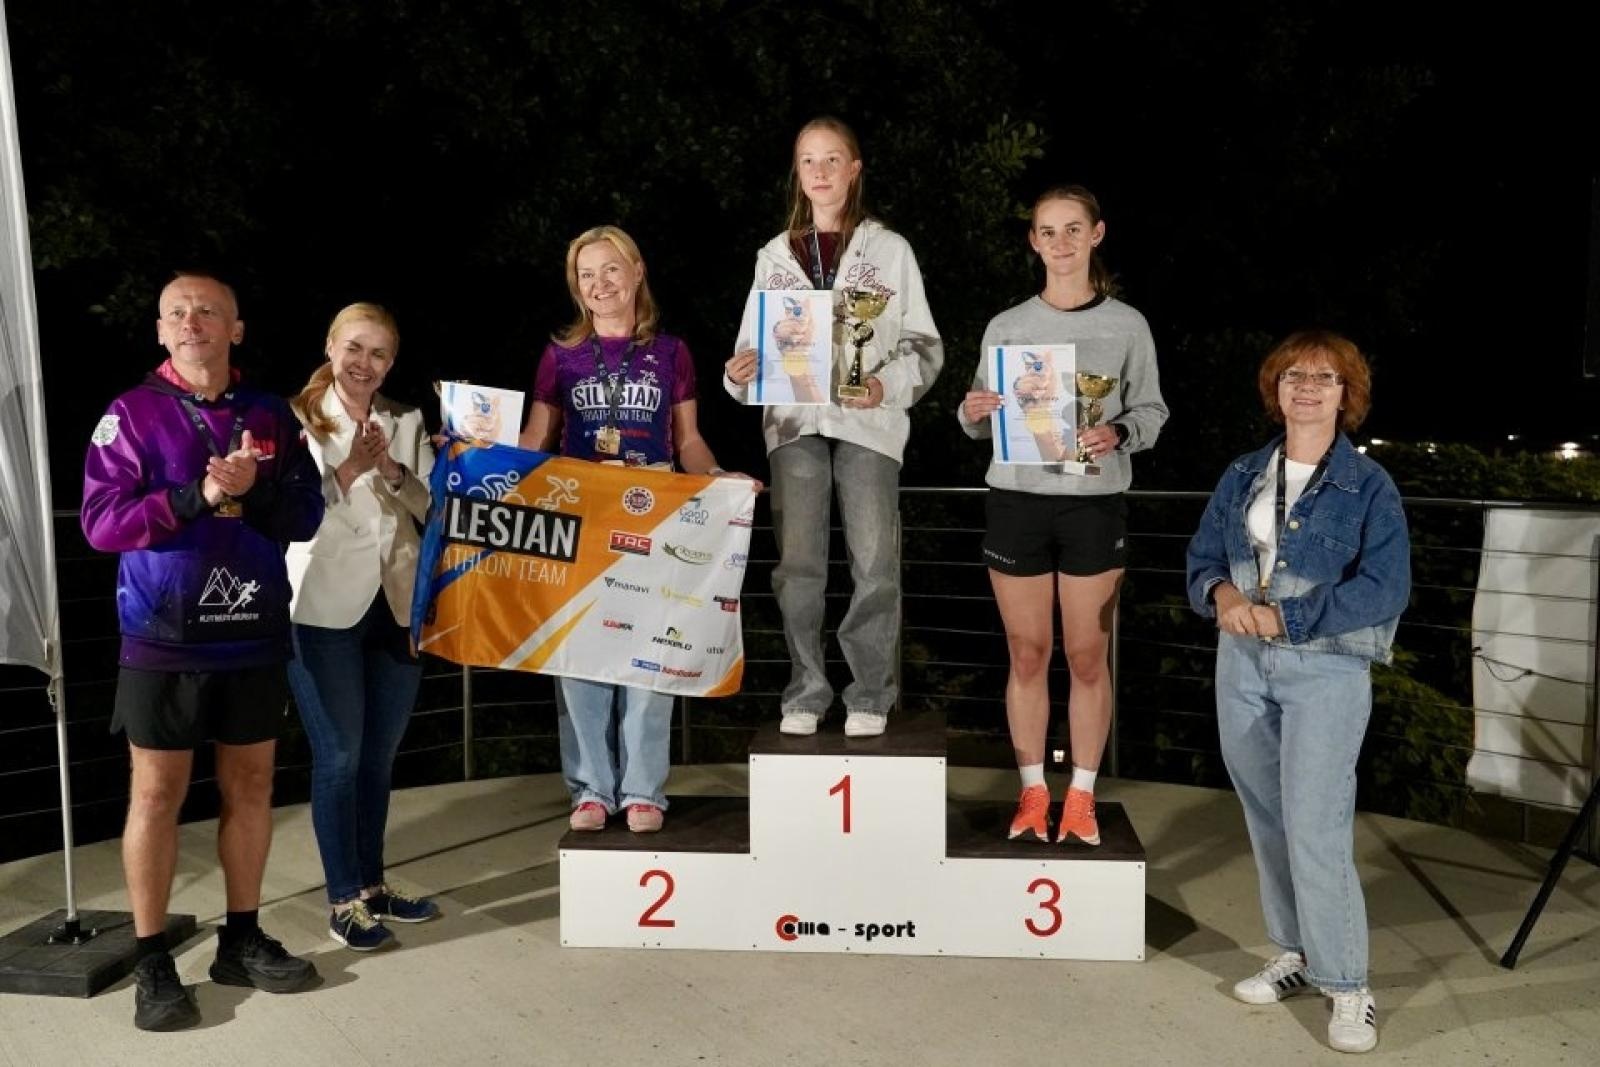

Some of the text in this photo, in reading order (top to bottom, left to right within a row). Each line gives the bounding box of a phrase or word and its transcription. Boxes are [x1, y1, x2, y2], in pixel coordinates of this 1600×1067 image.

[573, 385, 660, 410] SILSIAN
[445, 497, 576, 558] LESIAN
[519, 559, 567, 586] TEAM
[828, 775, 852, 834] 1
[637, 869, 676, 928] 2
[1024, 878, 1064, 938] 3
[854, 920, 916, 941] sport
